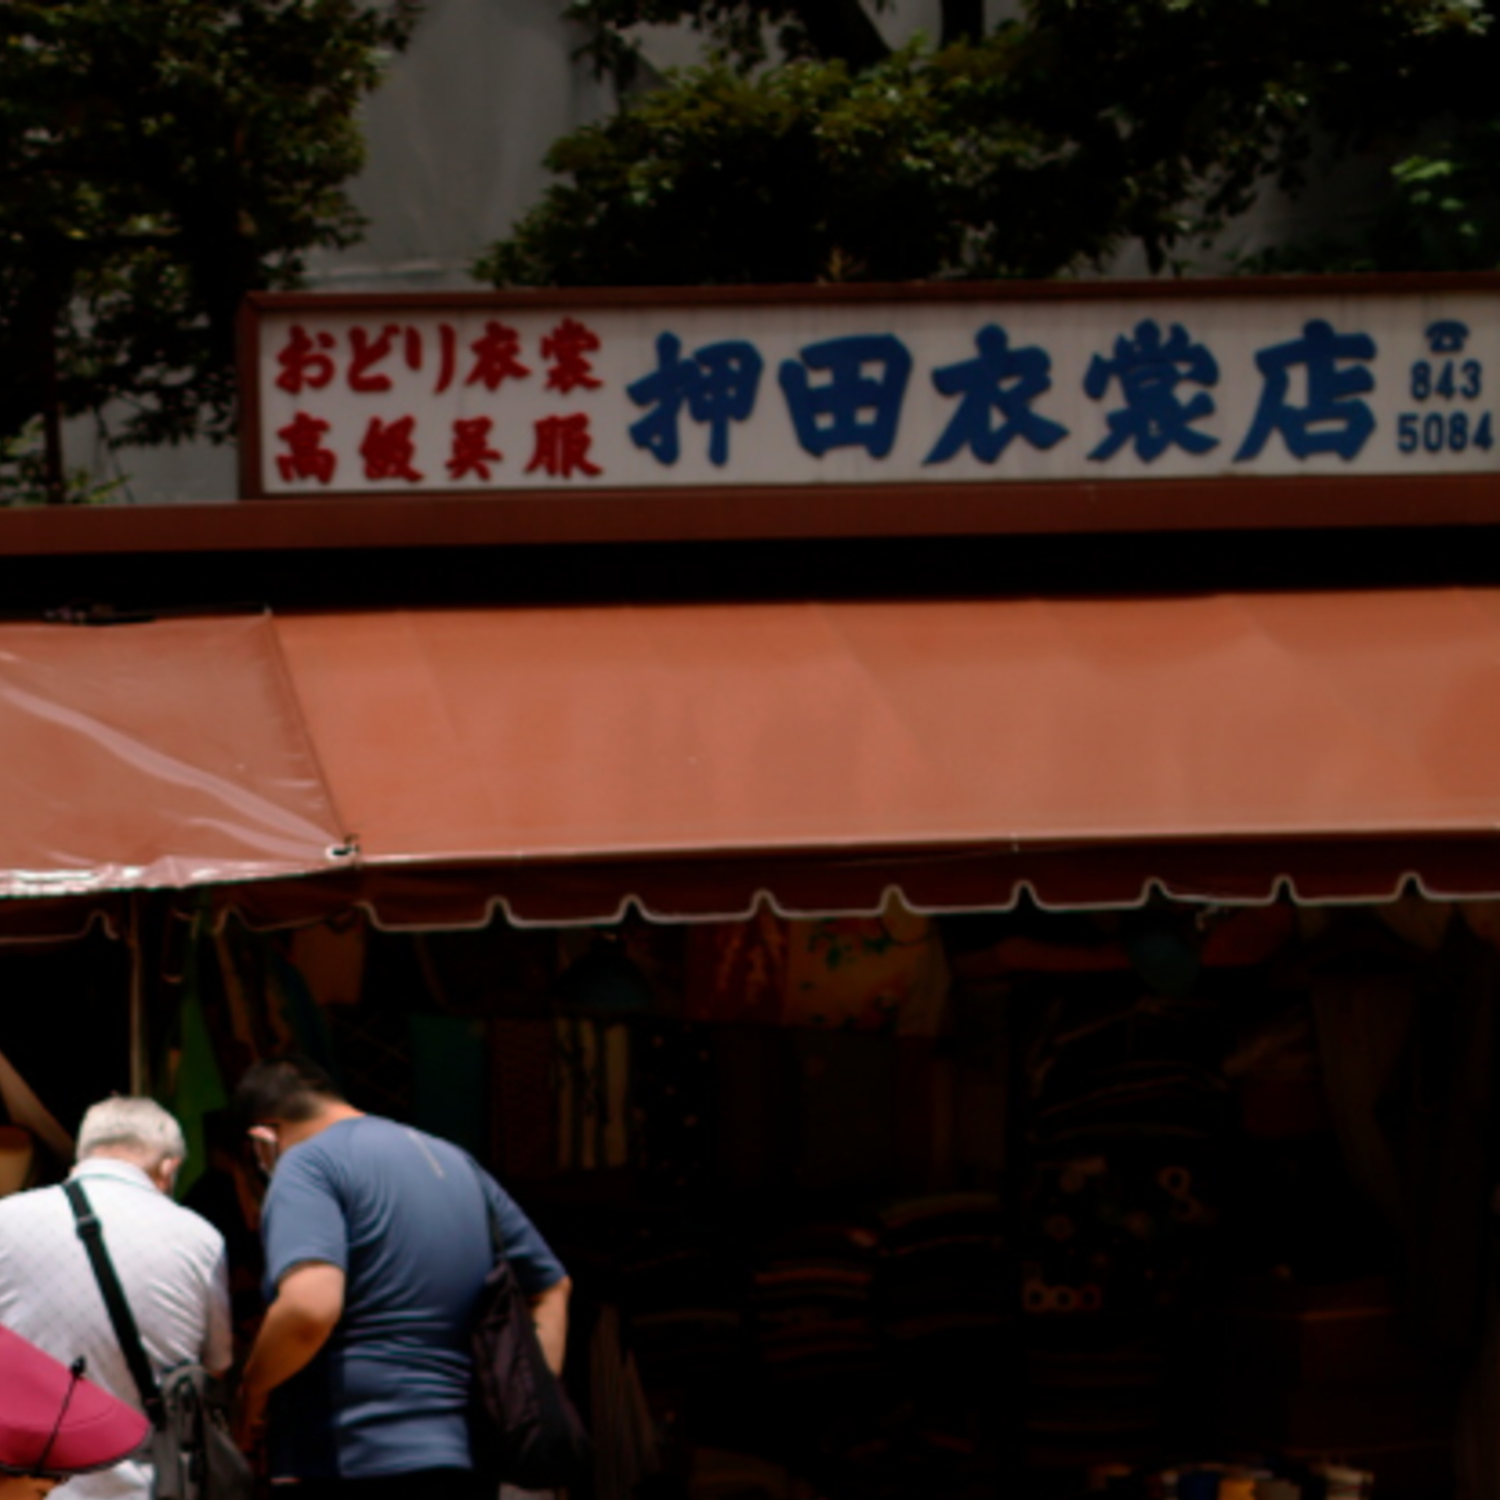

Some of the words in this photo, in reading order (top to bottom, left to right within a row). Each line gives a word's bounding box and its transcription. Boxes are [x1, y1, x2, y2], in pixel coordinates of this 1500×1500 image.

[626, 319, 1378, 467] 押田衣裳店
[1411, 357, 1483, 401] 843
[1396, 409, 1495, 453] 5084
